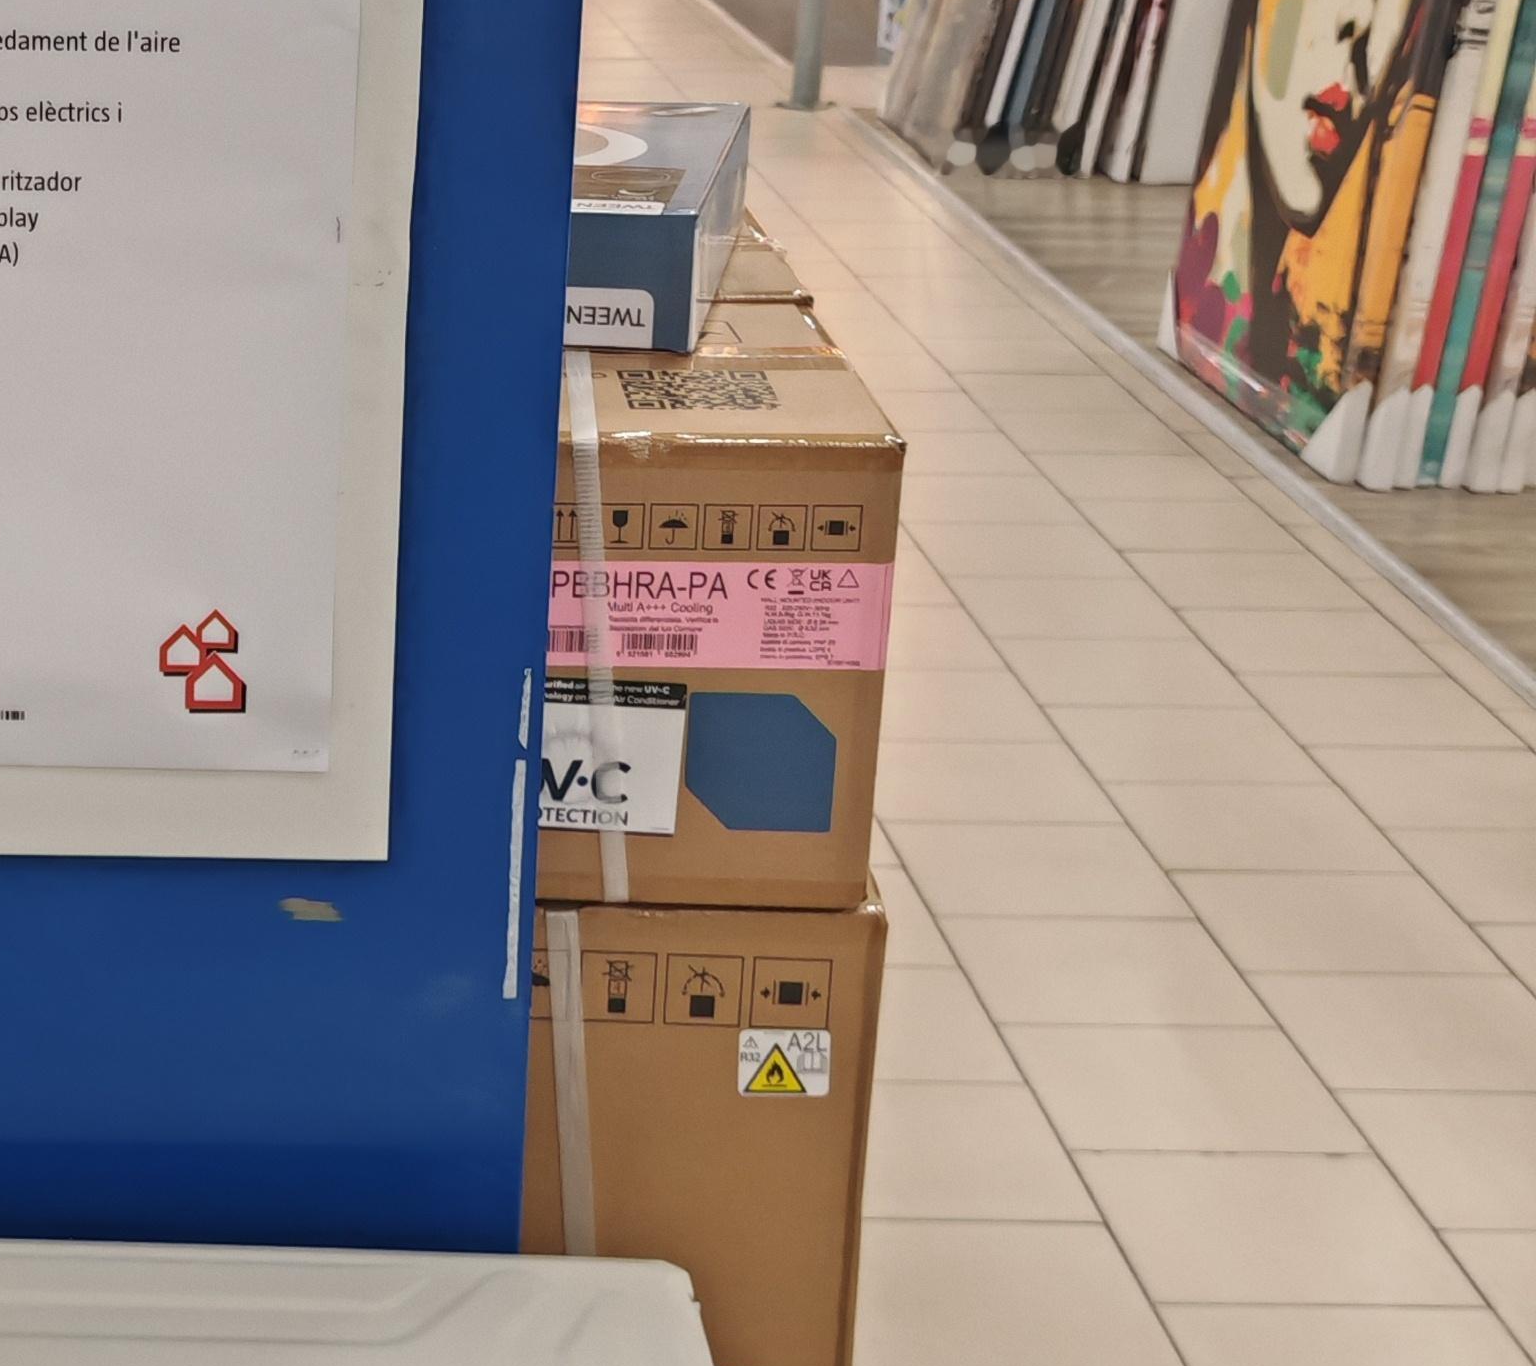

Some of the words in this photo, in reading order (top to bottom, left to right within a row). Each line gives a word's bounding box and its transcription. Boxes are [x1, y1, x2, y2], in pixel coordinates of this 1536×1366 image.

[94, 29, 120, 52] de
[127, 30, 181, 53] l'aire
[25, 100, 111, 123] elèctrics
[117, 101, 122, 124] i
[566, 305, 646, 328] TWEEN
[670, 602, 714, 615] Cooling
[539, 806, 629, 826] TECTION
[786, 1031, 828, 1053] A2L
